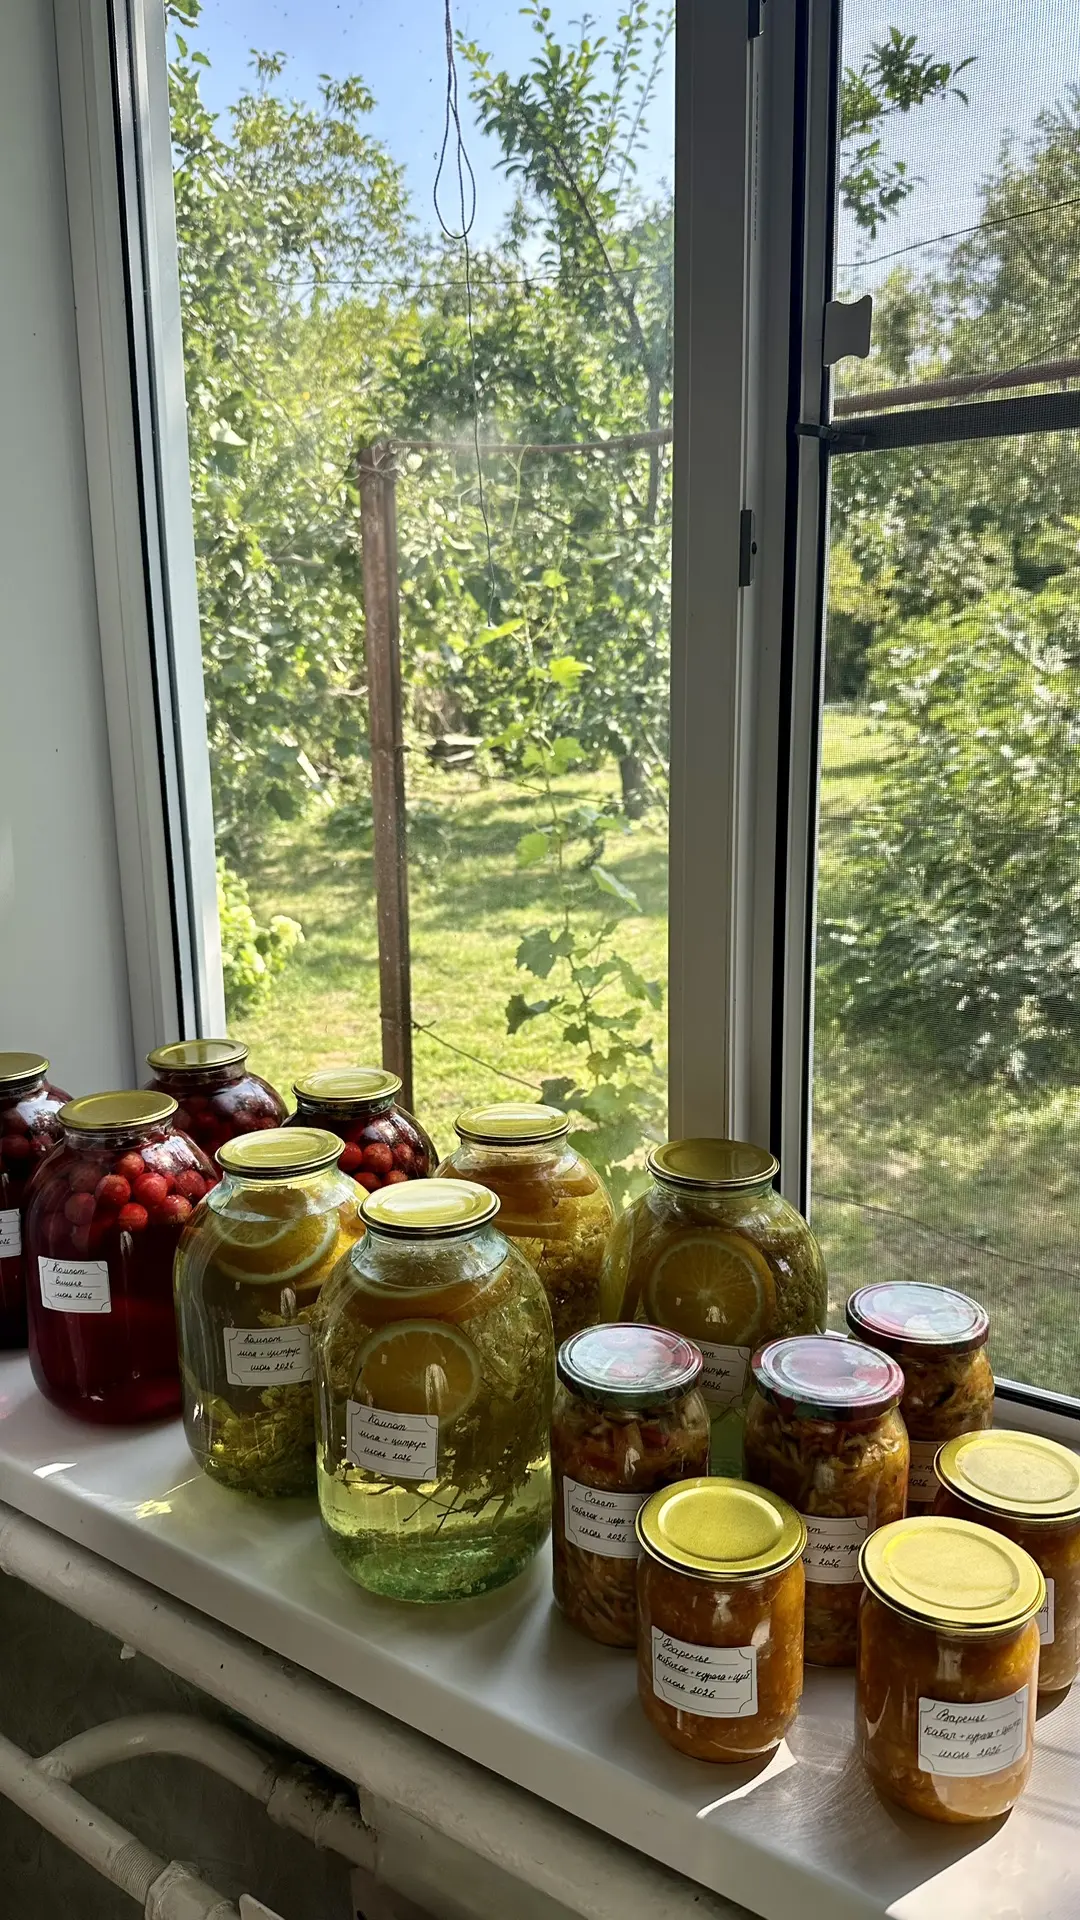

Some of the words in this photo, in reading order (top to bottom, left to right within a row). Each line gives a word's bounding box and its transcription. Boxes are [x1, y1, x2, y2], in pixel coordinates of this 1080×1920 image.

[52, 1262, 88, 1275] Компот
[243, 1334, 282, 1344] Компот
[267, 1347, 301, 1358] цитрус
[274, 1361, 295, 1371] 2026
[702, 1380, 721, 1390] 2026
[367, 1413, 407, 1432] Компот
[391, 1437, 427, 1451] цитрус
[363, 1446, 387, 1458] июль
[392, 1452, 412, 1462] 2026
[585, 1490, 618, 1508] Салат
[578, 1525, 601, 1539] июль
[607, 1532, 628, 1543] 2026
[818, 1557, 842, 1568] 2026
[662, 1638, 712, 1664] Варенье
[662, 1675, 686, 1691] июль
[689, 1685, 717, 1699] 2026
[938, 1748, 970, 1760] июль
[977, 1744, 1003, 1758] 2026
